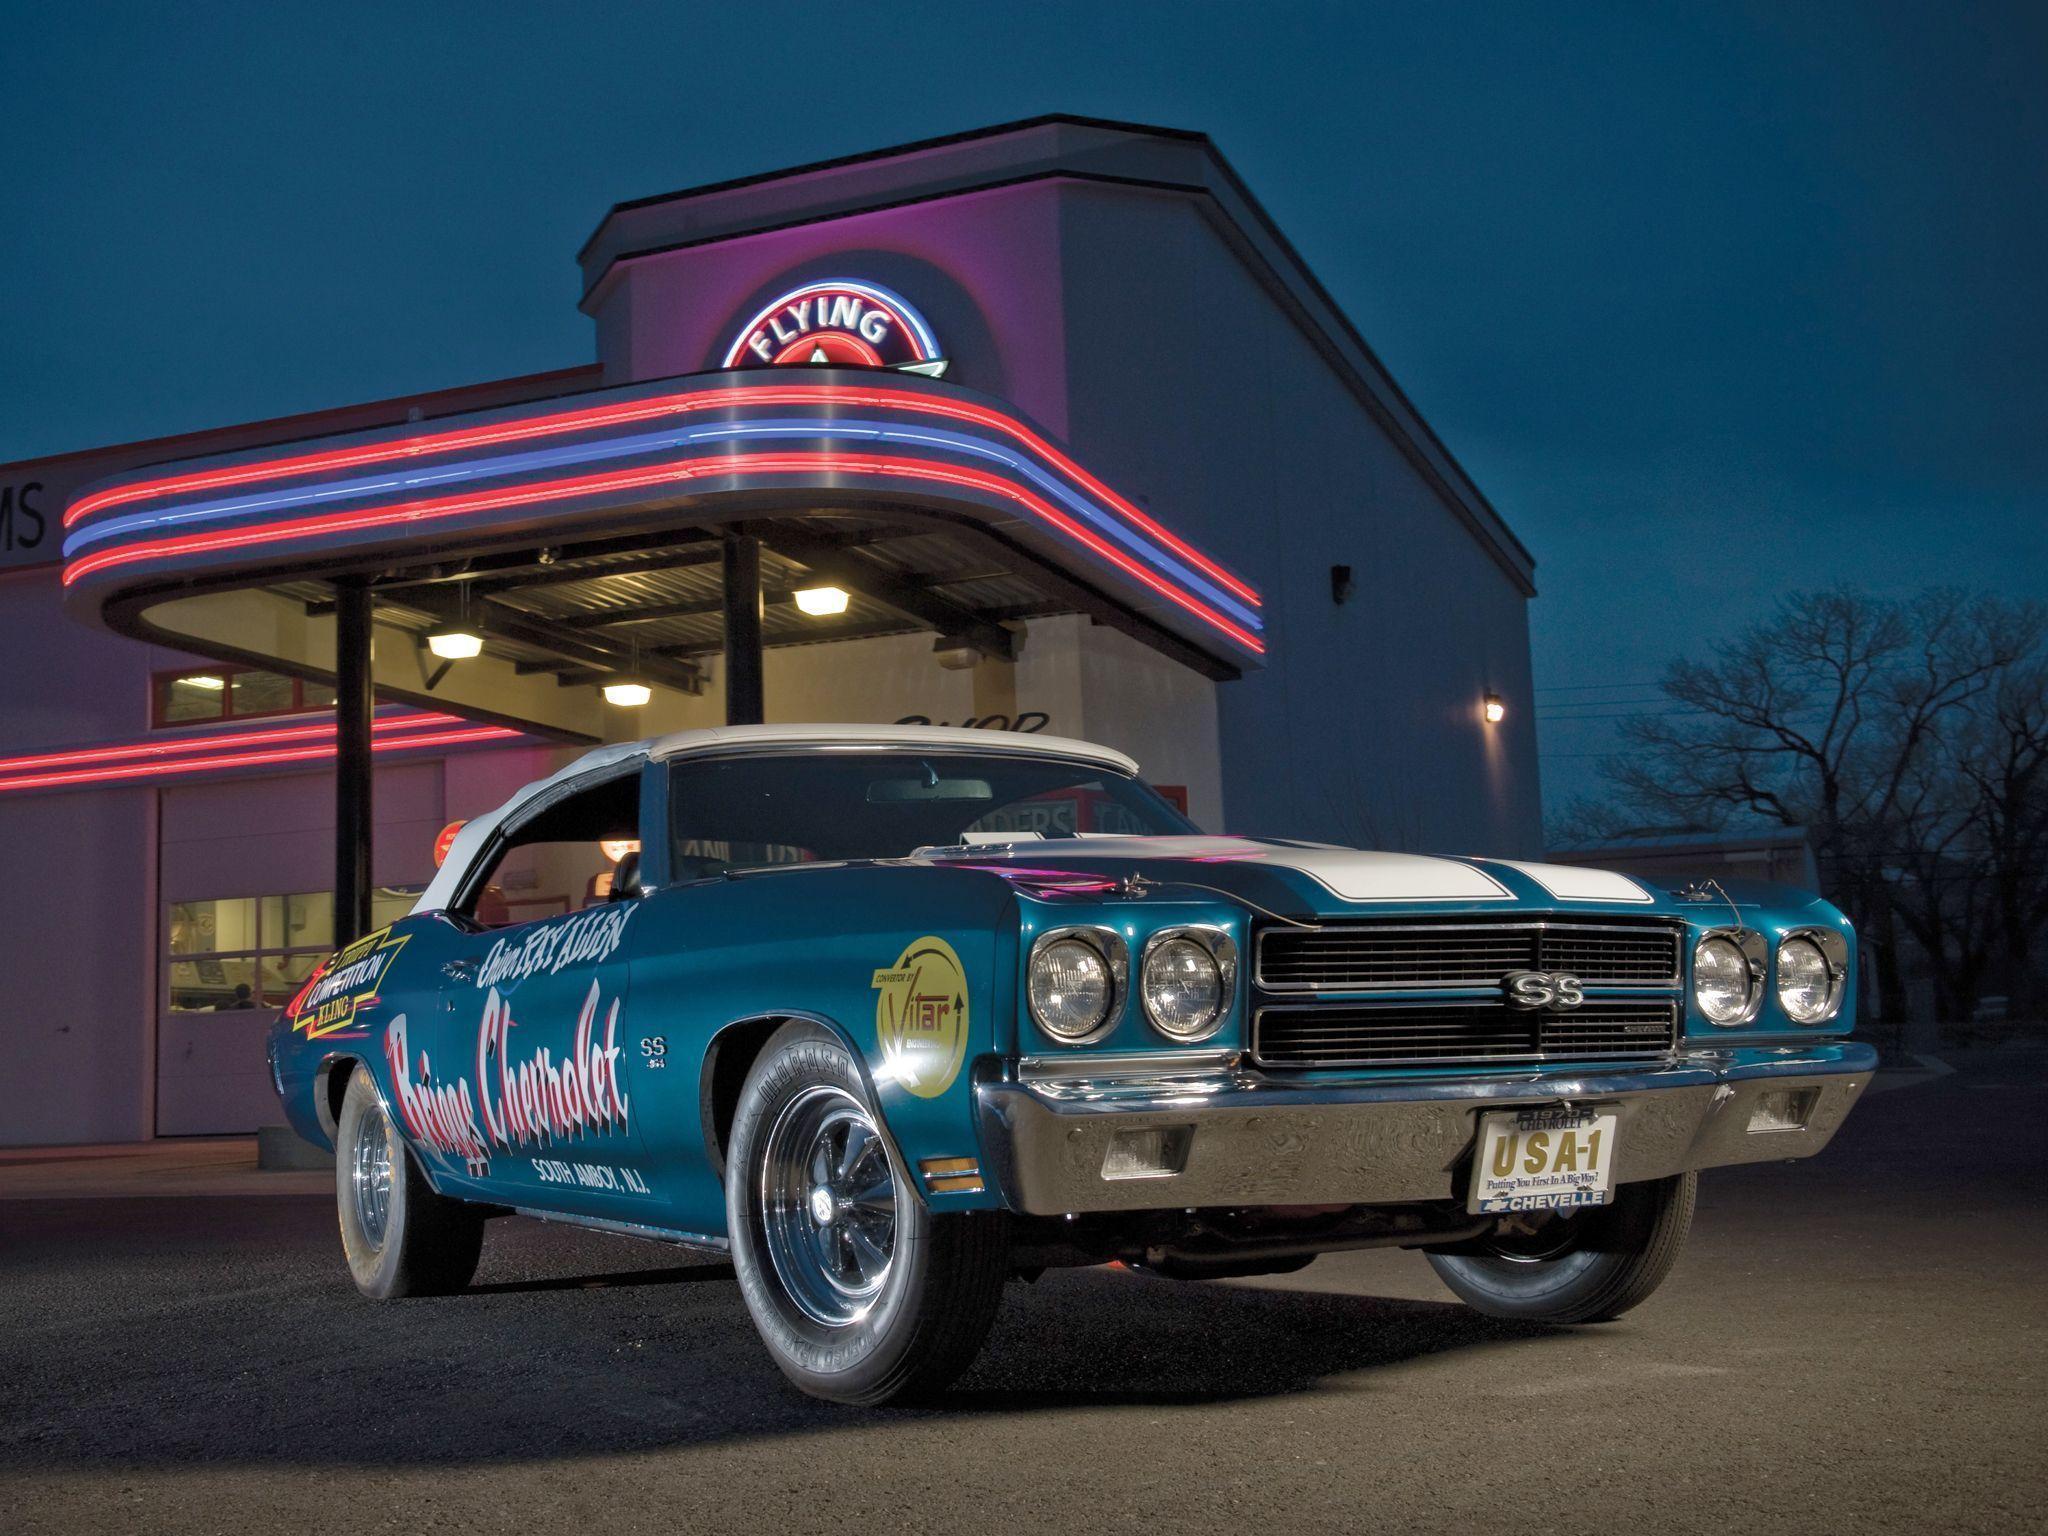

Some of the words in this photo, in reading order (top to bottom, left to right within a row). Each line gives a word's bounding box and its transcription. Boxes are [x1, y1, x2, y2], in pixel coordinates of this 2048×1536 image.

[748, 295, 893, 362] FLYING
[512, 916, 577, 980] RAY
[551, 902, 639, 975] ALLEN
[306, 952, 387, 1009] COMPETITION
[1508, 972, 1585, 1011] SS
[317, 996, 349, 1027] KLING
[887, 965, 950, 1042] Vitar
[640, 1036, 667, 1056] SS
[384, 1013, 491, 1177] Briggs
[476, 977, 629, 1156] Chevrolet
[1520, 1117, 1582, 1131] CHEVROLET
[1491, 1128, 1602, 1177] USA-1
[531, 1158, 577, 1185] SOUTH
[573, 1163, 625, 1193] AMBOY,
[1486, 1179, 1516, 1191] Putting
[1516, 1178, 1530, 1188] You
[1532, 1176, 1549, 1187] First
[1551, 1175, 1560, 1185] In
[1560, 1175, 1569, 1184] A
[1569, 1173, 1581, 1185] Big
[1509, 1191, 1604, 1211] CHEVELLE
